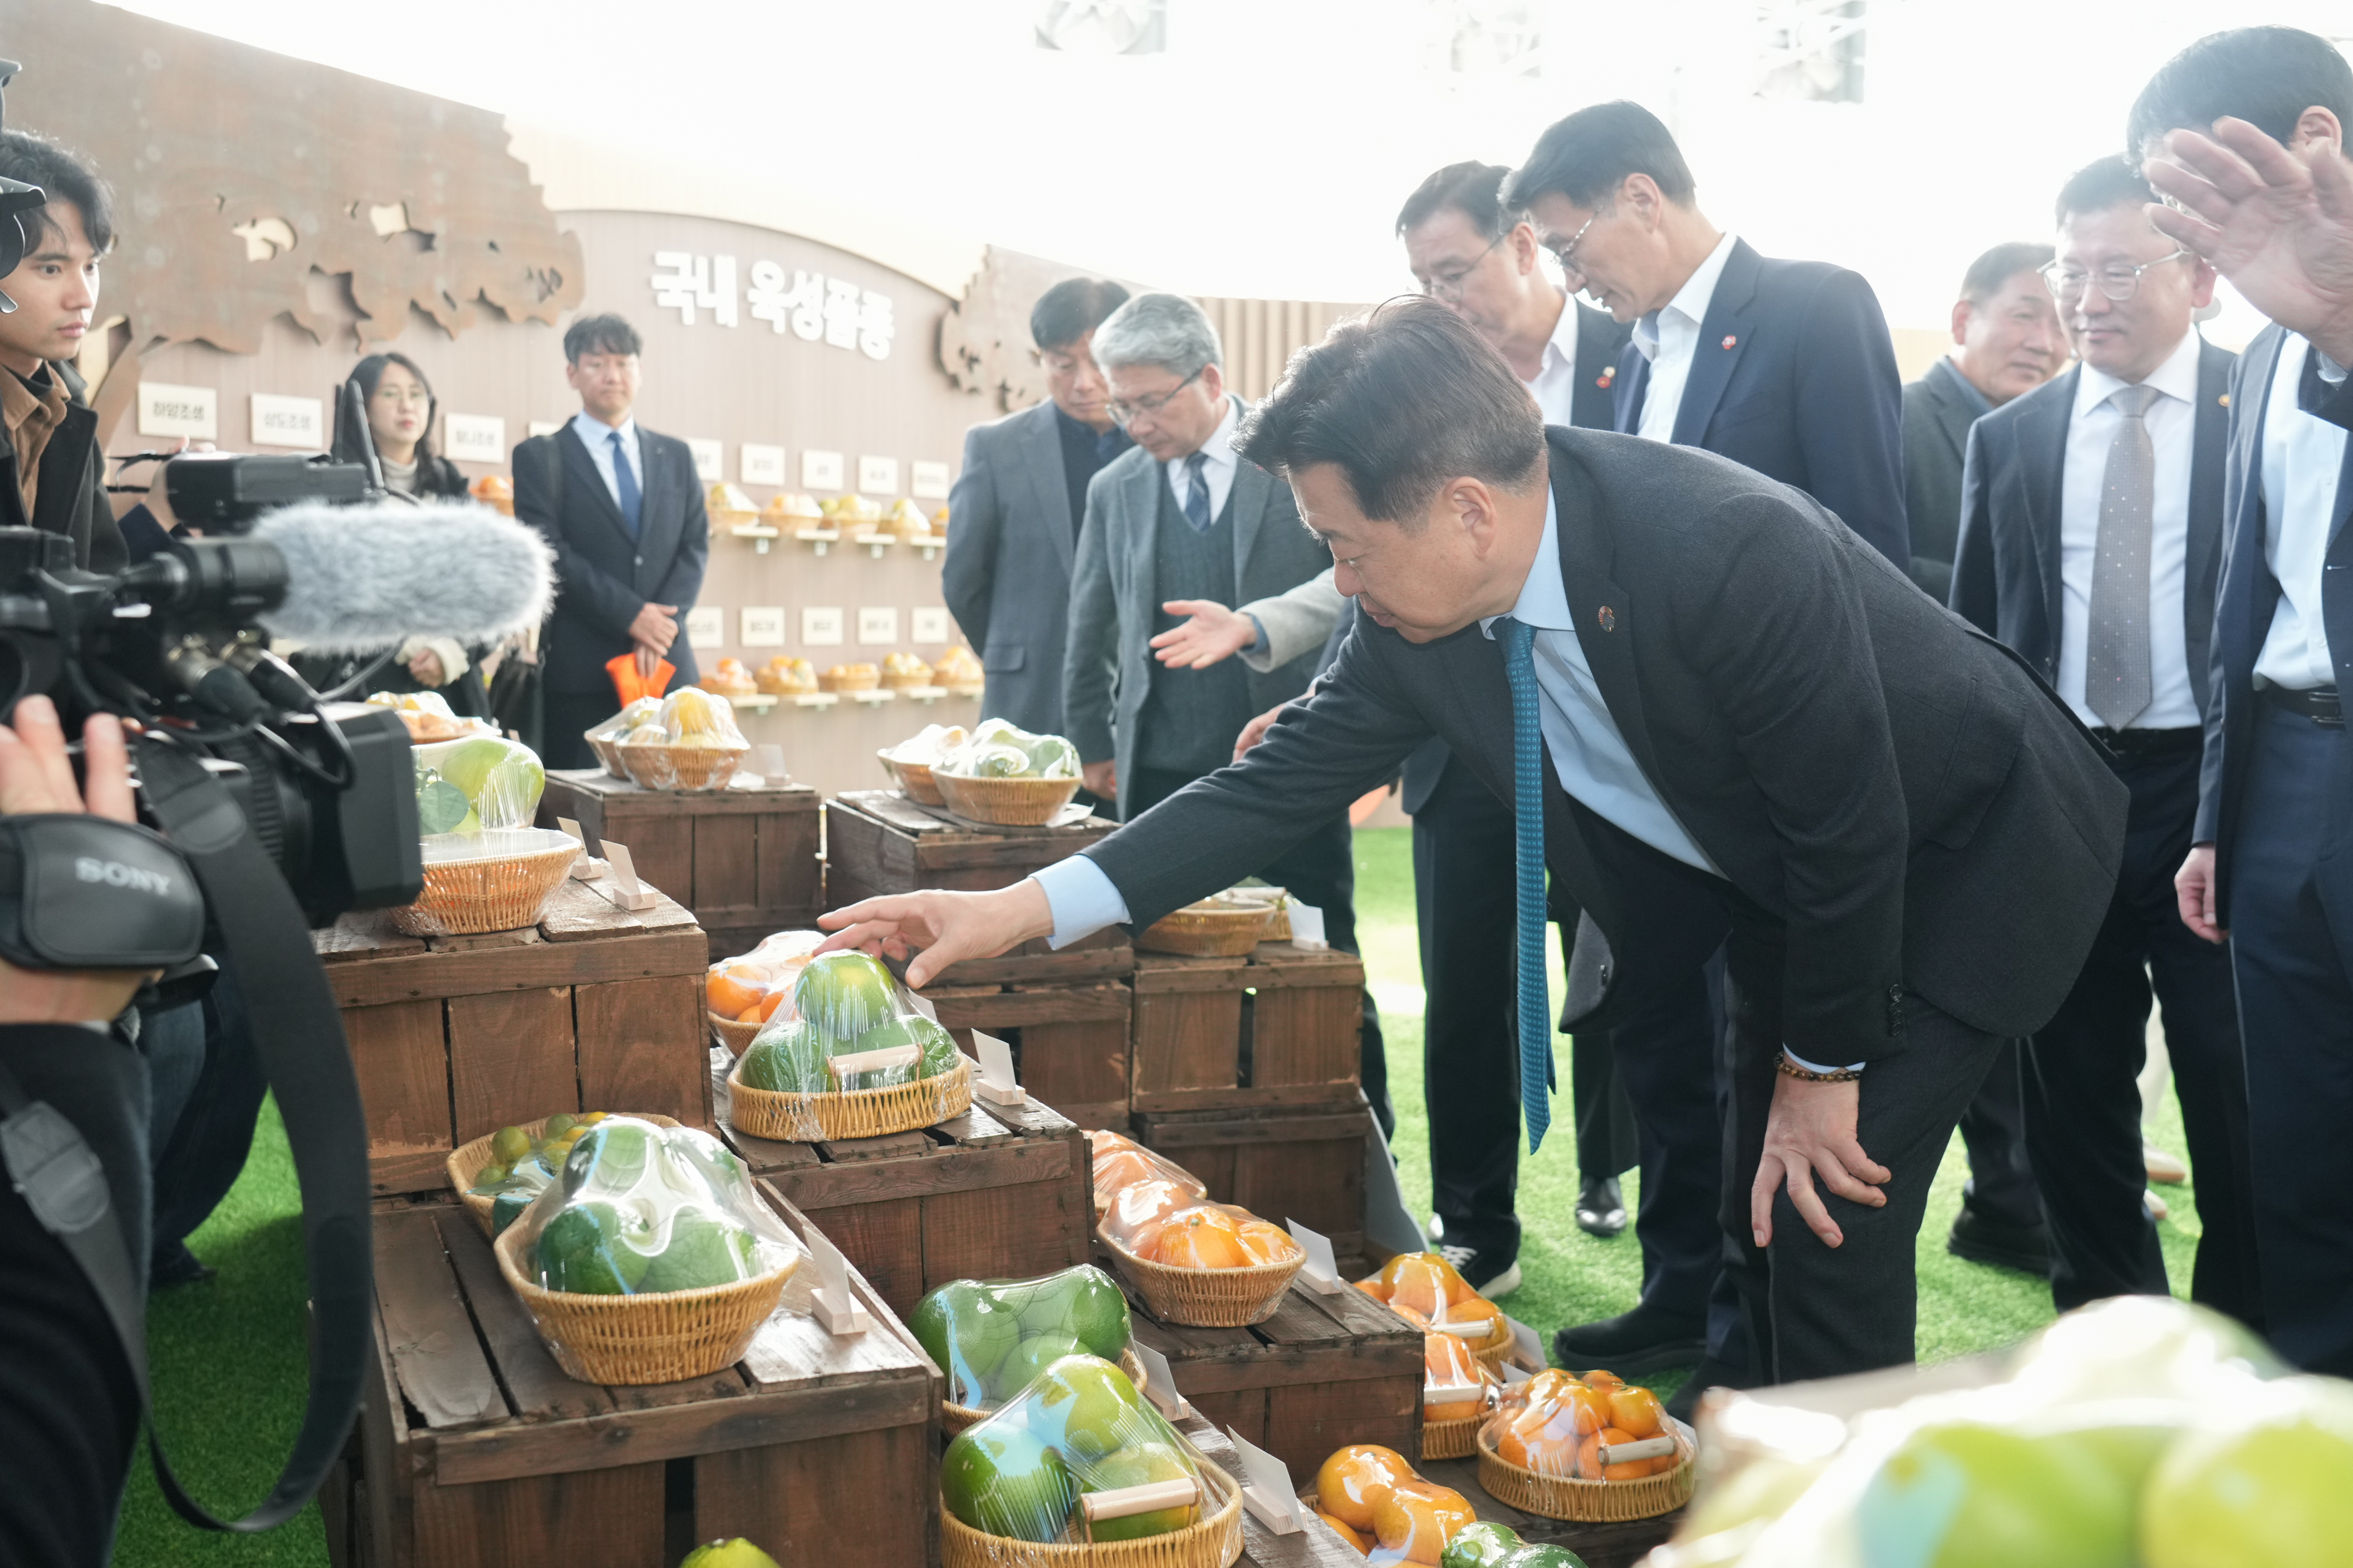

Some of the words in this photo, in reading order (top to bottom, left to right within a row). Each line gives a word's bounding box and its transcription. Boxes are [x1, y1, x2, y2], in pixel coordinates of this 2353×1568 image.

[651, 251, 738, 328] 국내
[747, 259, 895, 361] 육성품종
[75, 857, 170, 896] SONY
